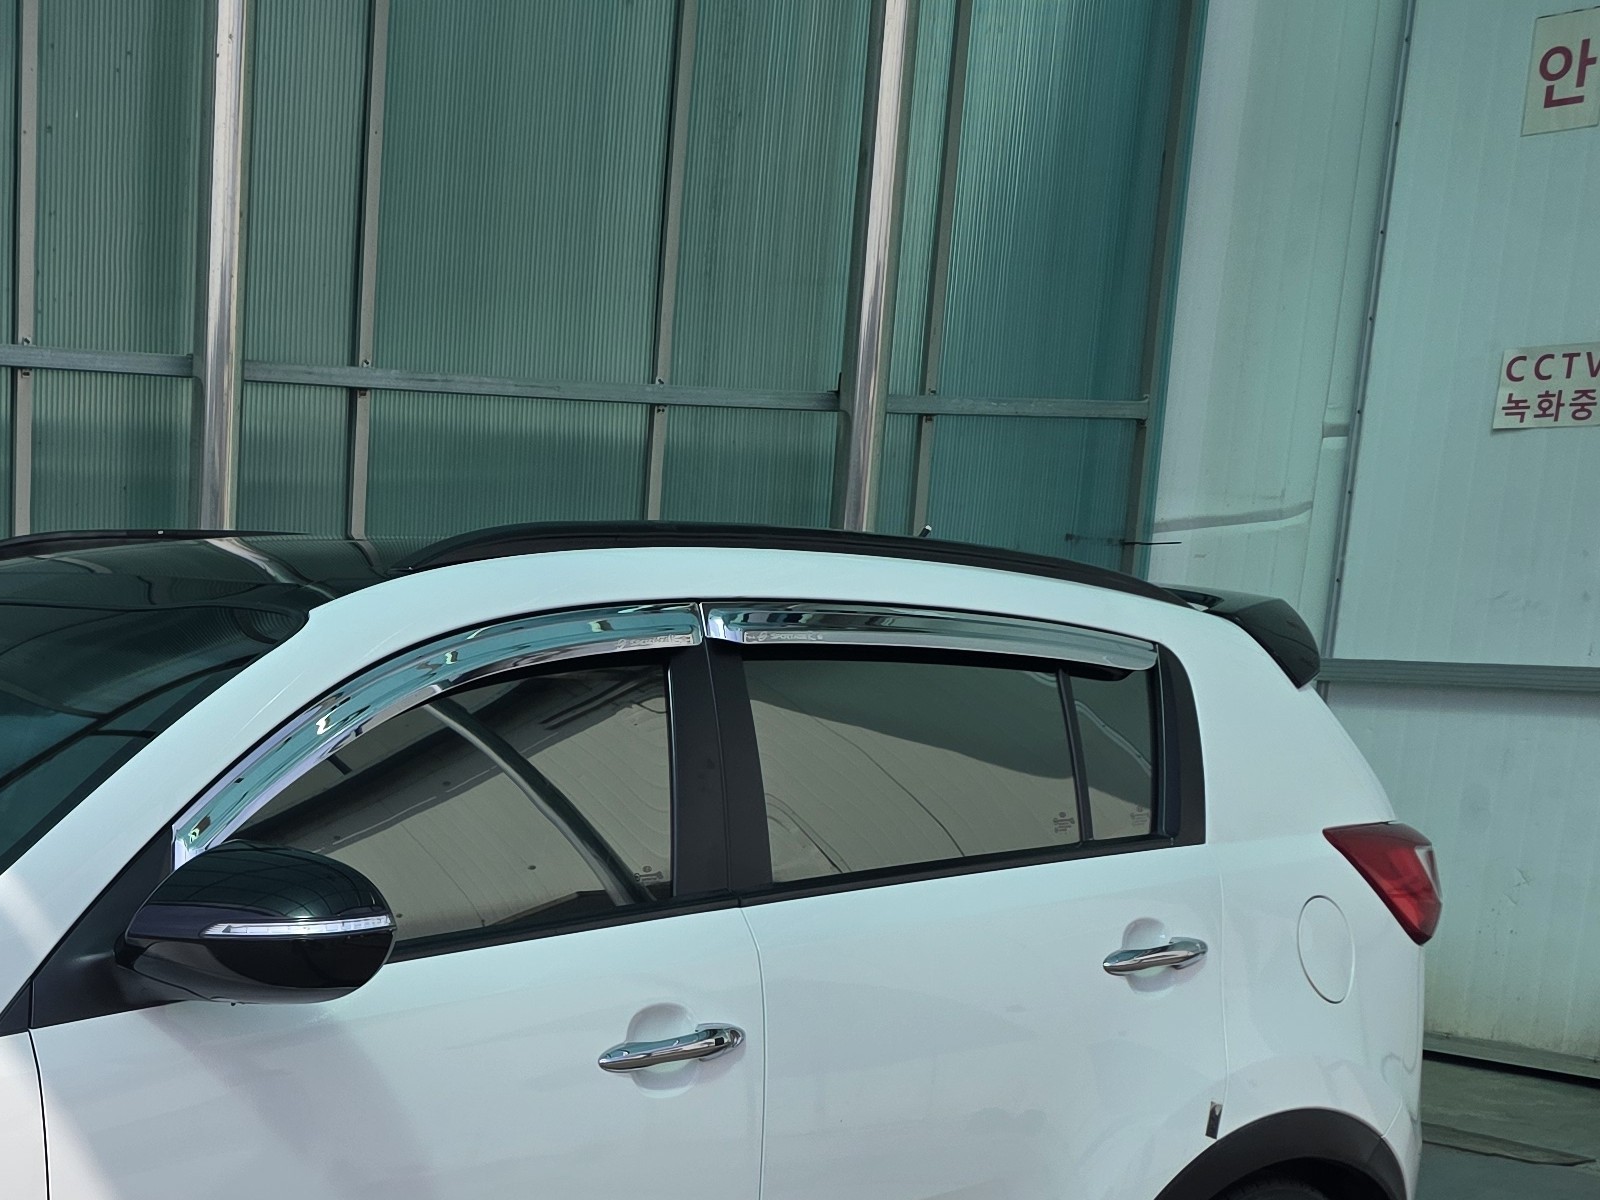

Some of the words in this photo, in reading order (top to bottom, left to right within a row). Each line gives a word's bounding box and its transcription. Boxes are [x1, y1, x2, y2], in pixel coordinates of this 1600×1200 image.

[1539, 38, 1598, 109] 안
[1506, 352, 1600, 382] CCTV
[1501, 388, 1598, 423] 녹화중
